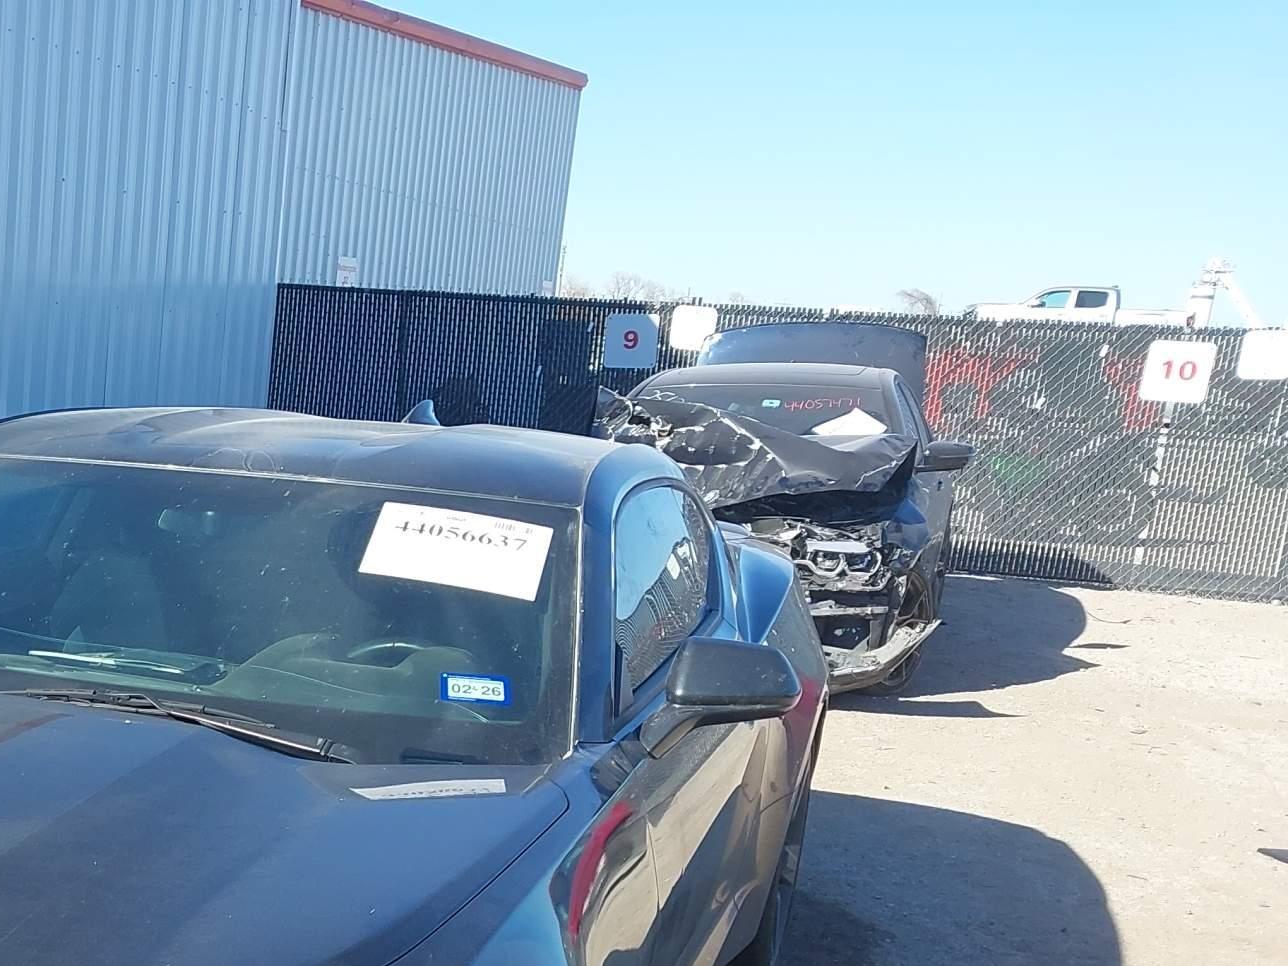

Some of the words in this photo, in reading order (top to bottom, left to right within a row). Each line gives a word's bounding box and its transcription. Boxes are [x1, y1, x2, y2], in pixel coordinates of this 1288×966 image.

[623, 330, 640, 350] 9
[1161, 359, 1198, 381] 10
[395, 520, 528, 551] 44056637
